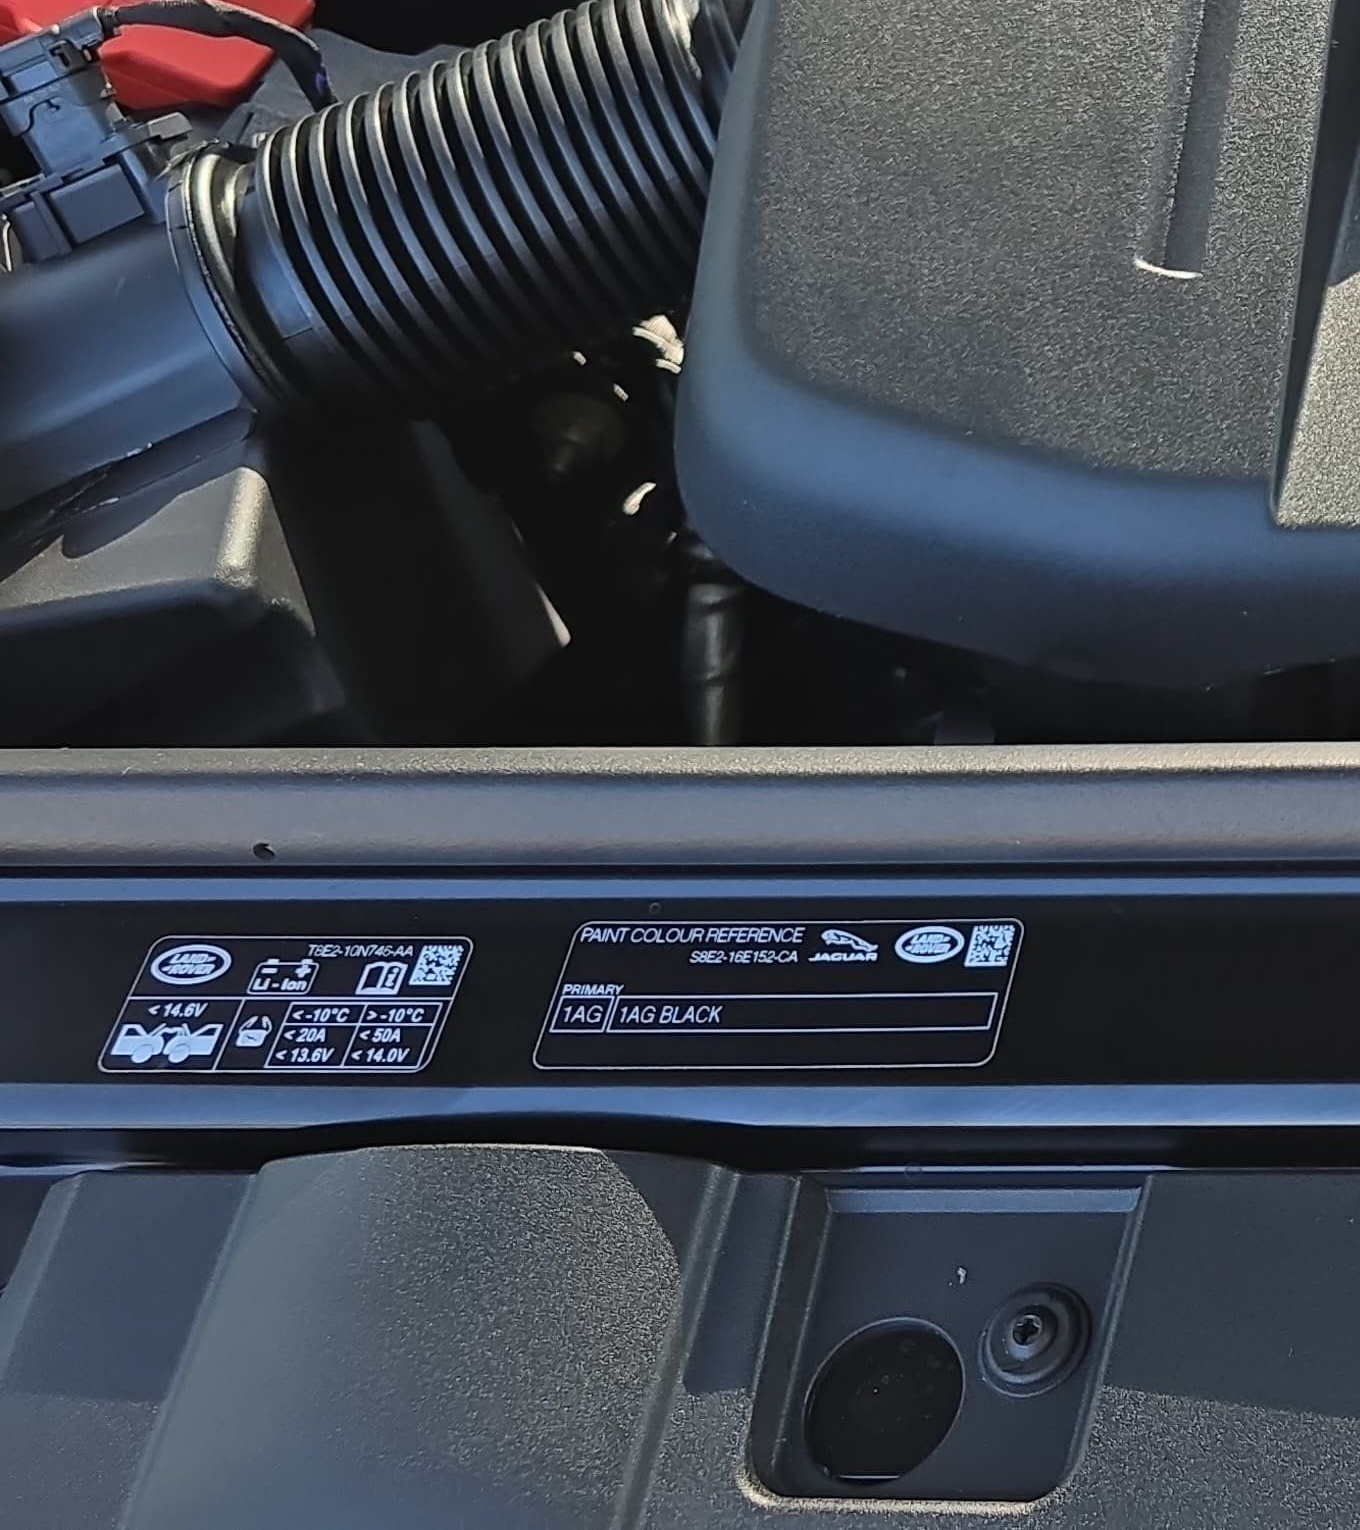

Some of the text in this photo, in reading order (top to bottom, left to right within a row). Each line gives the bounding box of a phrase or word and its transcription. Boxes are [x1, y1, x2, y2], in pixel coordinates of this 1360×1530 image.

[580, 926, 805, 943] PAINT COLOUR REFERENCE
[808, 952, 878, 962] JAGUAR
[562, 984, 624, 995] PRIMARY
[163, 1002, 209, 1017] 14.6V
[563, 1005, 604, 1024] 1AG
[619, 1005, 724, 1024] 1AG BLACK
[296, 1028, 326, 1042] 20A
[372, 1028, 401, 1042] 50A
[290, 1047, 335, 1062] 13.6V
[365, 1047, 410, 1062] 14.0V
